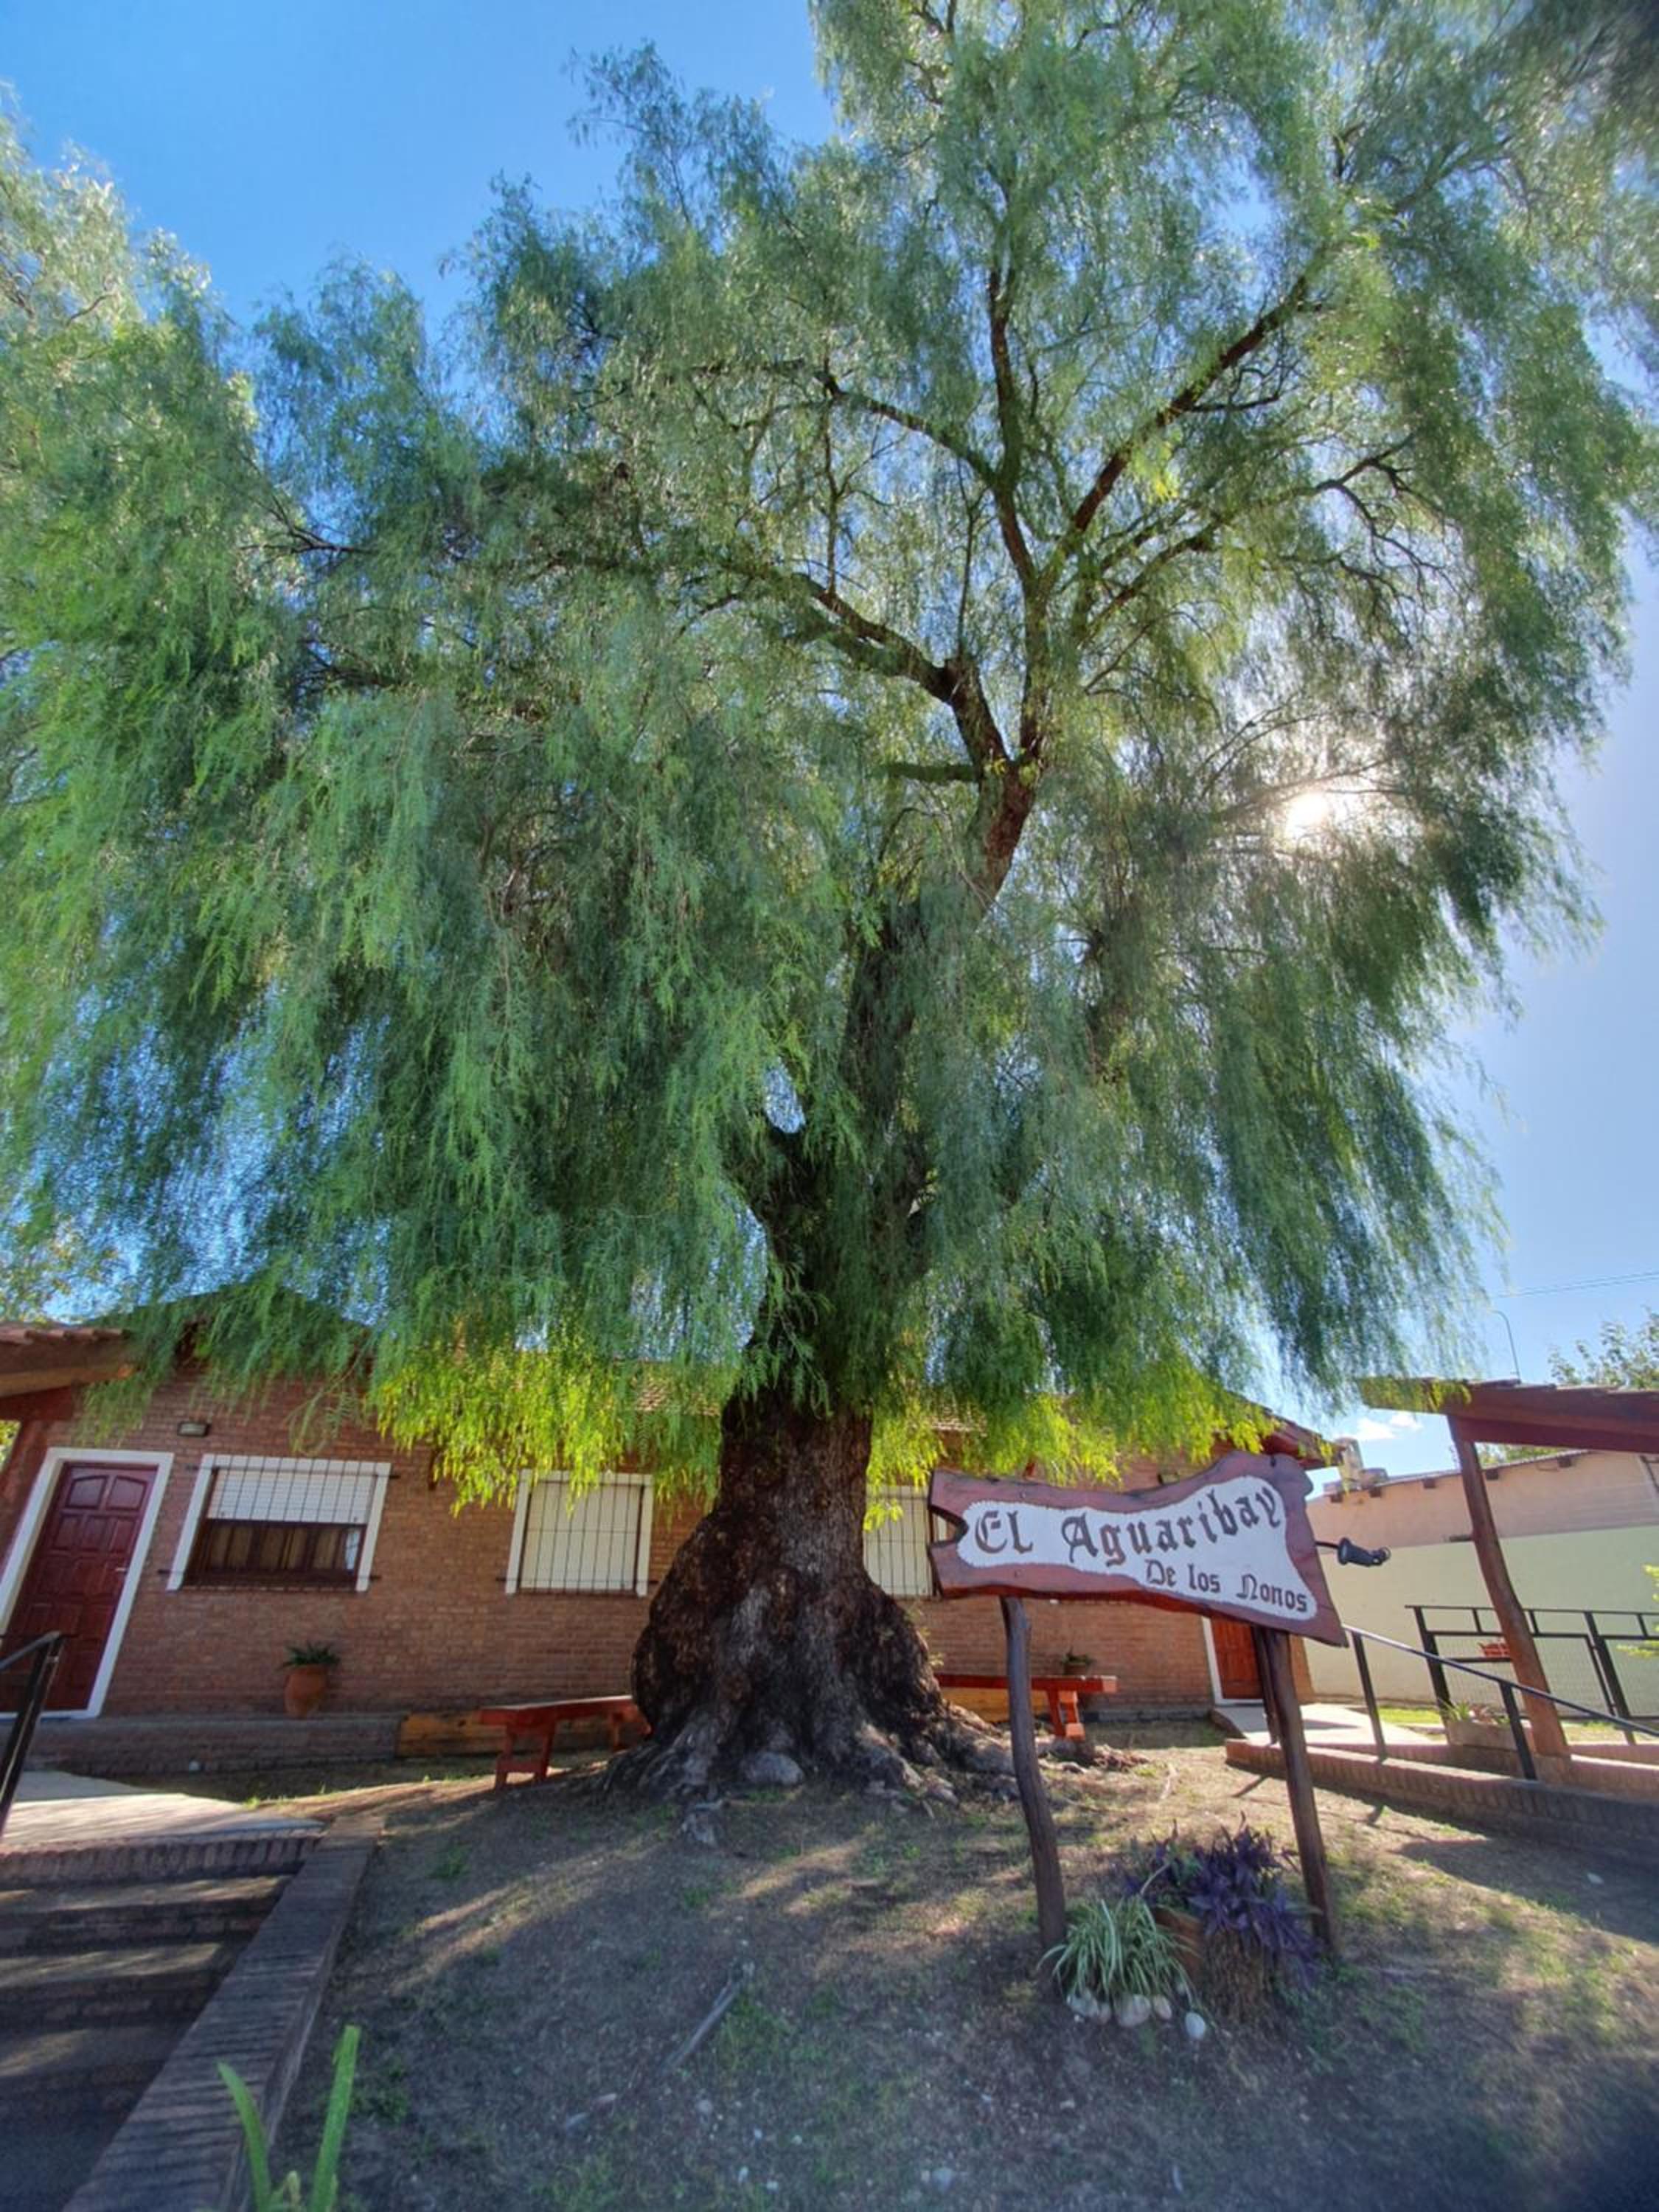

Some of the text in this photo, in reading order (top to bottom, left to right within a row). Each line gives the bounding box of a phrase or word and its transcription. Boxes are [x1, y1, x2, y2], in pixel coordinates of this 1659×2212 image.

[1062, 1486, 1281, 1566] Aguaribay
[1145, 1559, 1308, 1613] De los Nonos
